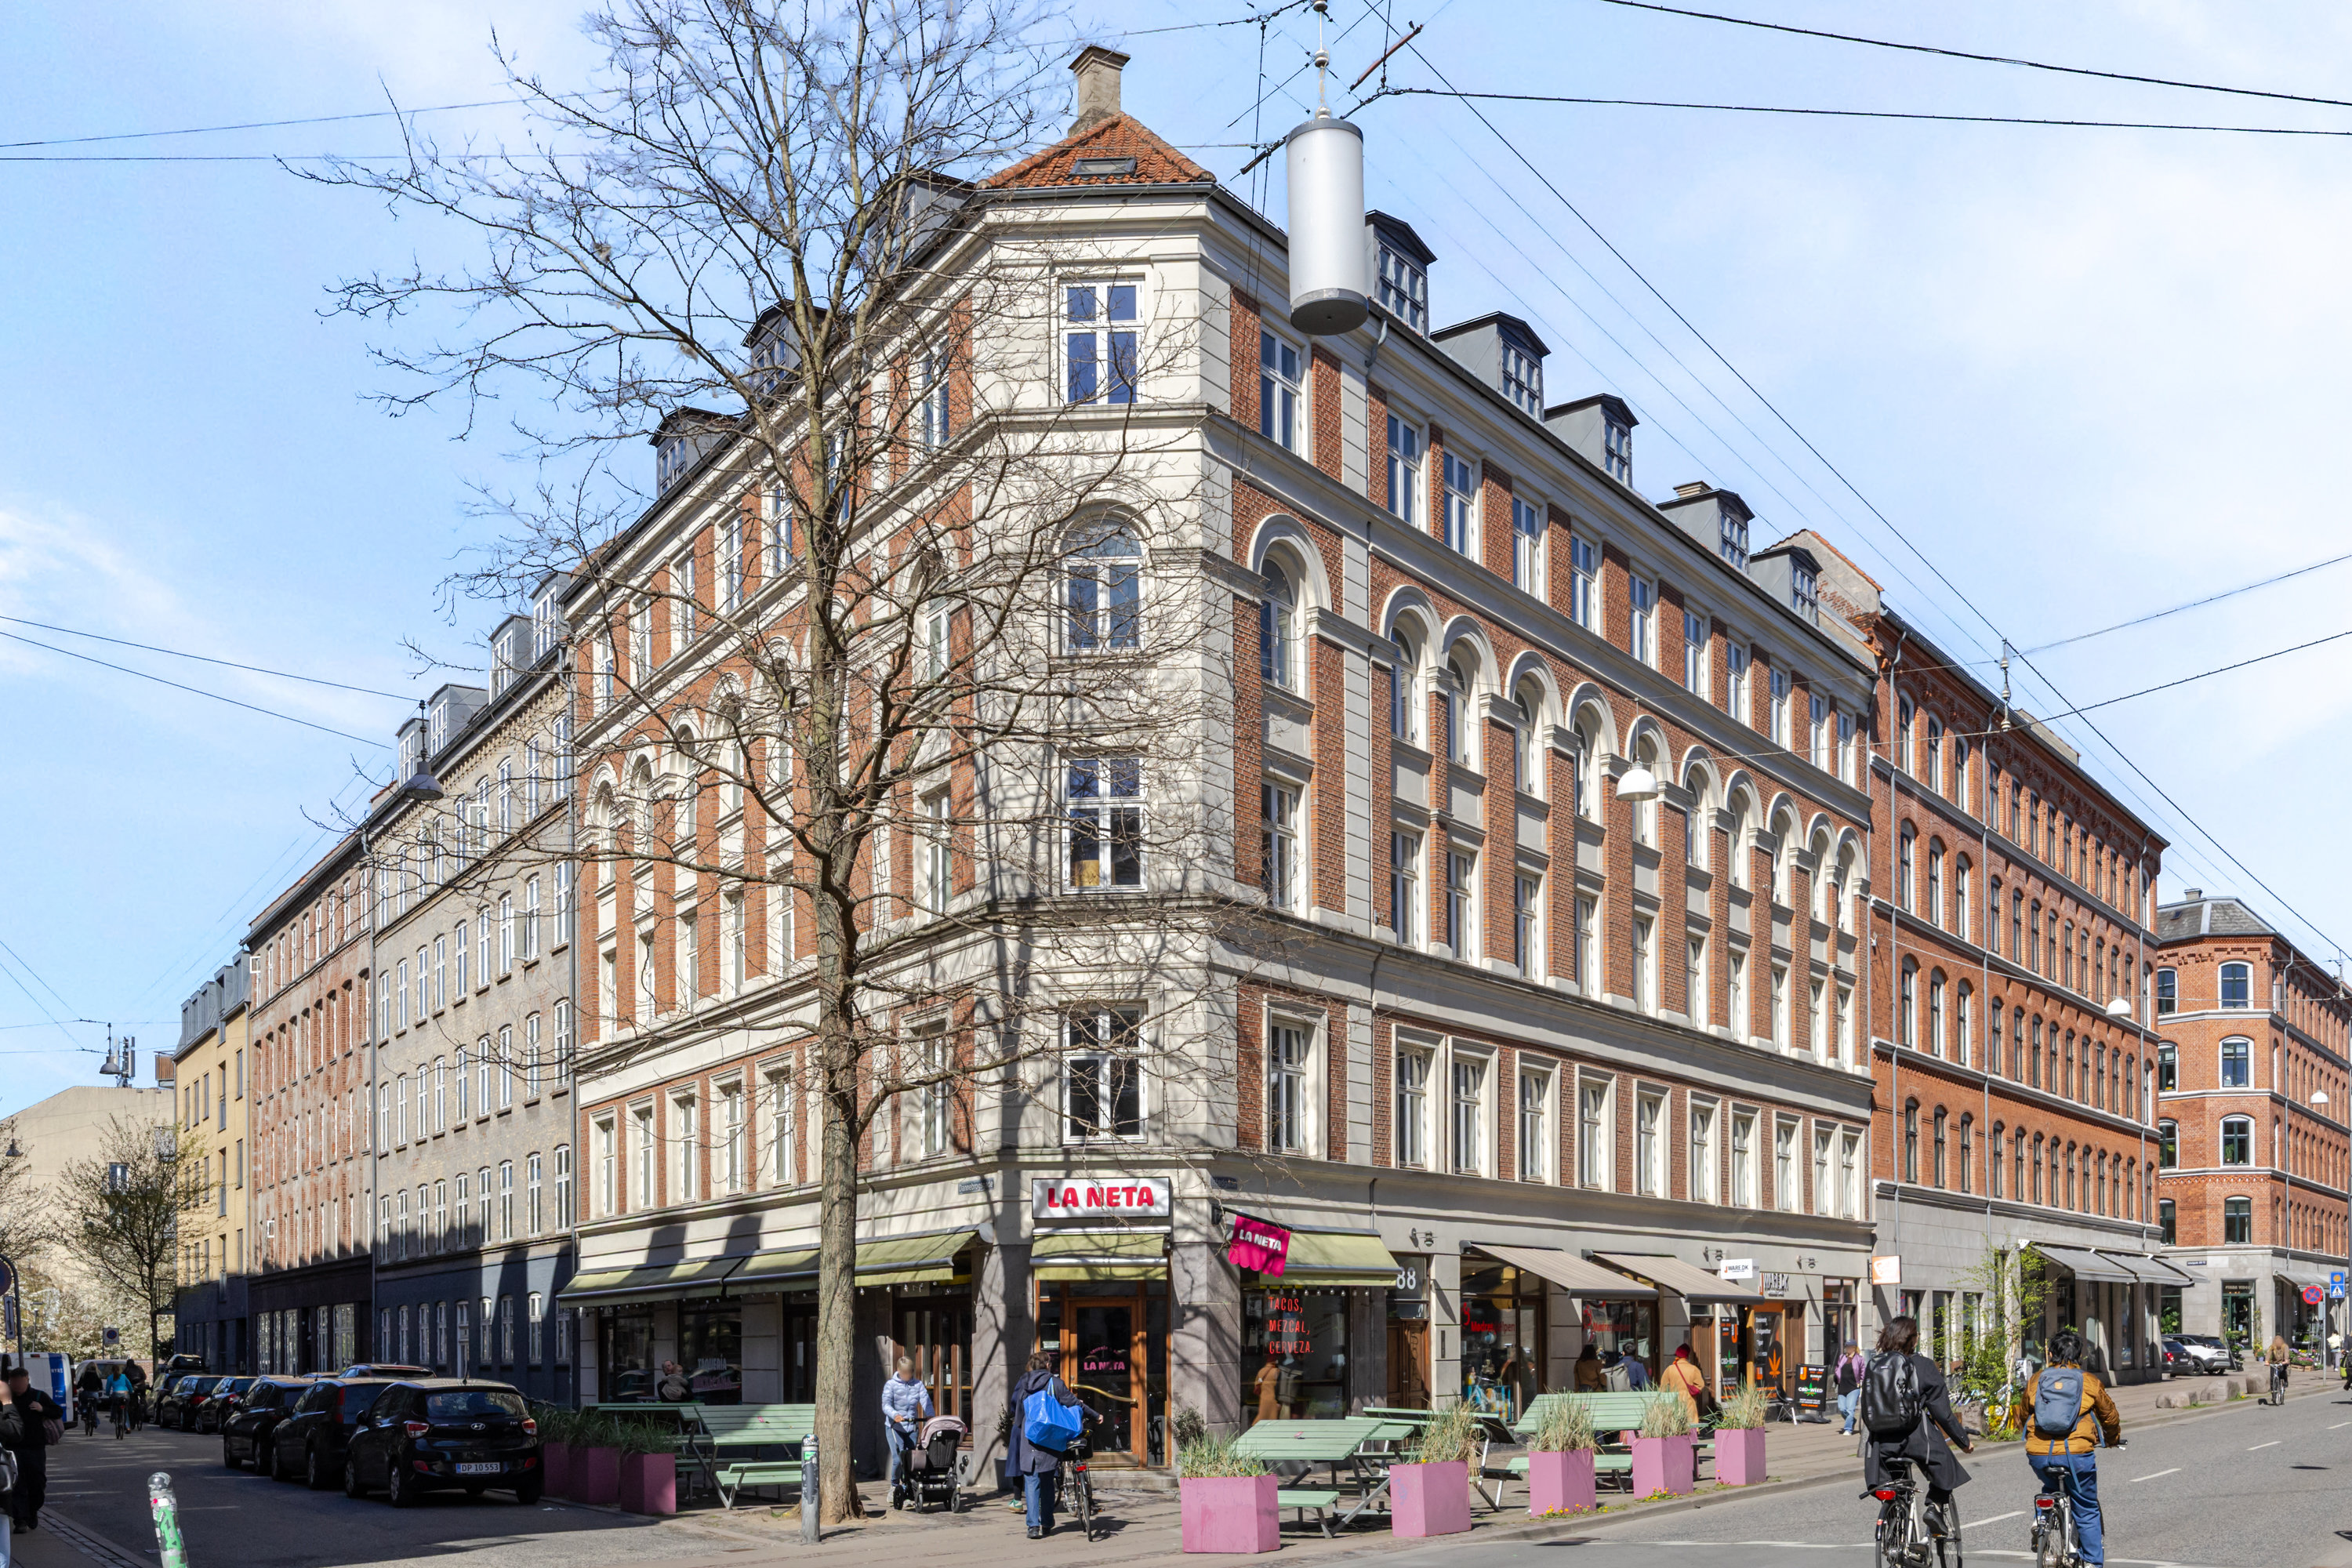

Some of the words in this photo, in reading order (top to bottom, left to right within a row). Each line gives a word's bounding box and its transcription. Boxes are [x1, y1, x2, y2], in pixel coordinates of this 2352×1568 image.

[959, 1181, 993, 1192] Dannebrogsde
[1048, 1188, 1079, 1207] LA
[1087, 1187, 1154, 1207] NETA
[1240, 1229, 1252, 1242] LA
[1254, 1234, 1281, 1251] NETA
[1396, 1266, 1416, 1290] 88
[1268, 1297, 1303, 1313] TACOS,
[1269, 1319, 1310, 1335] MEZCAL,
[1269, 1341, 1314, 1354] CERVEZA.
[1083, 1362, 1097, 1370] LA
[461, 1464, 472, 1472] DP
[485, 1463, 499, 1472] 553
